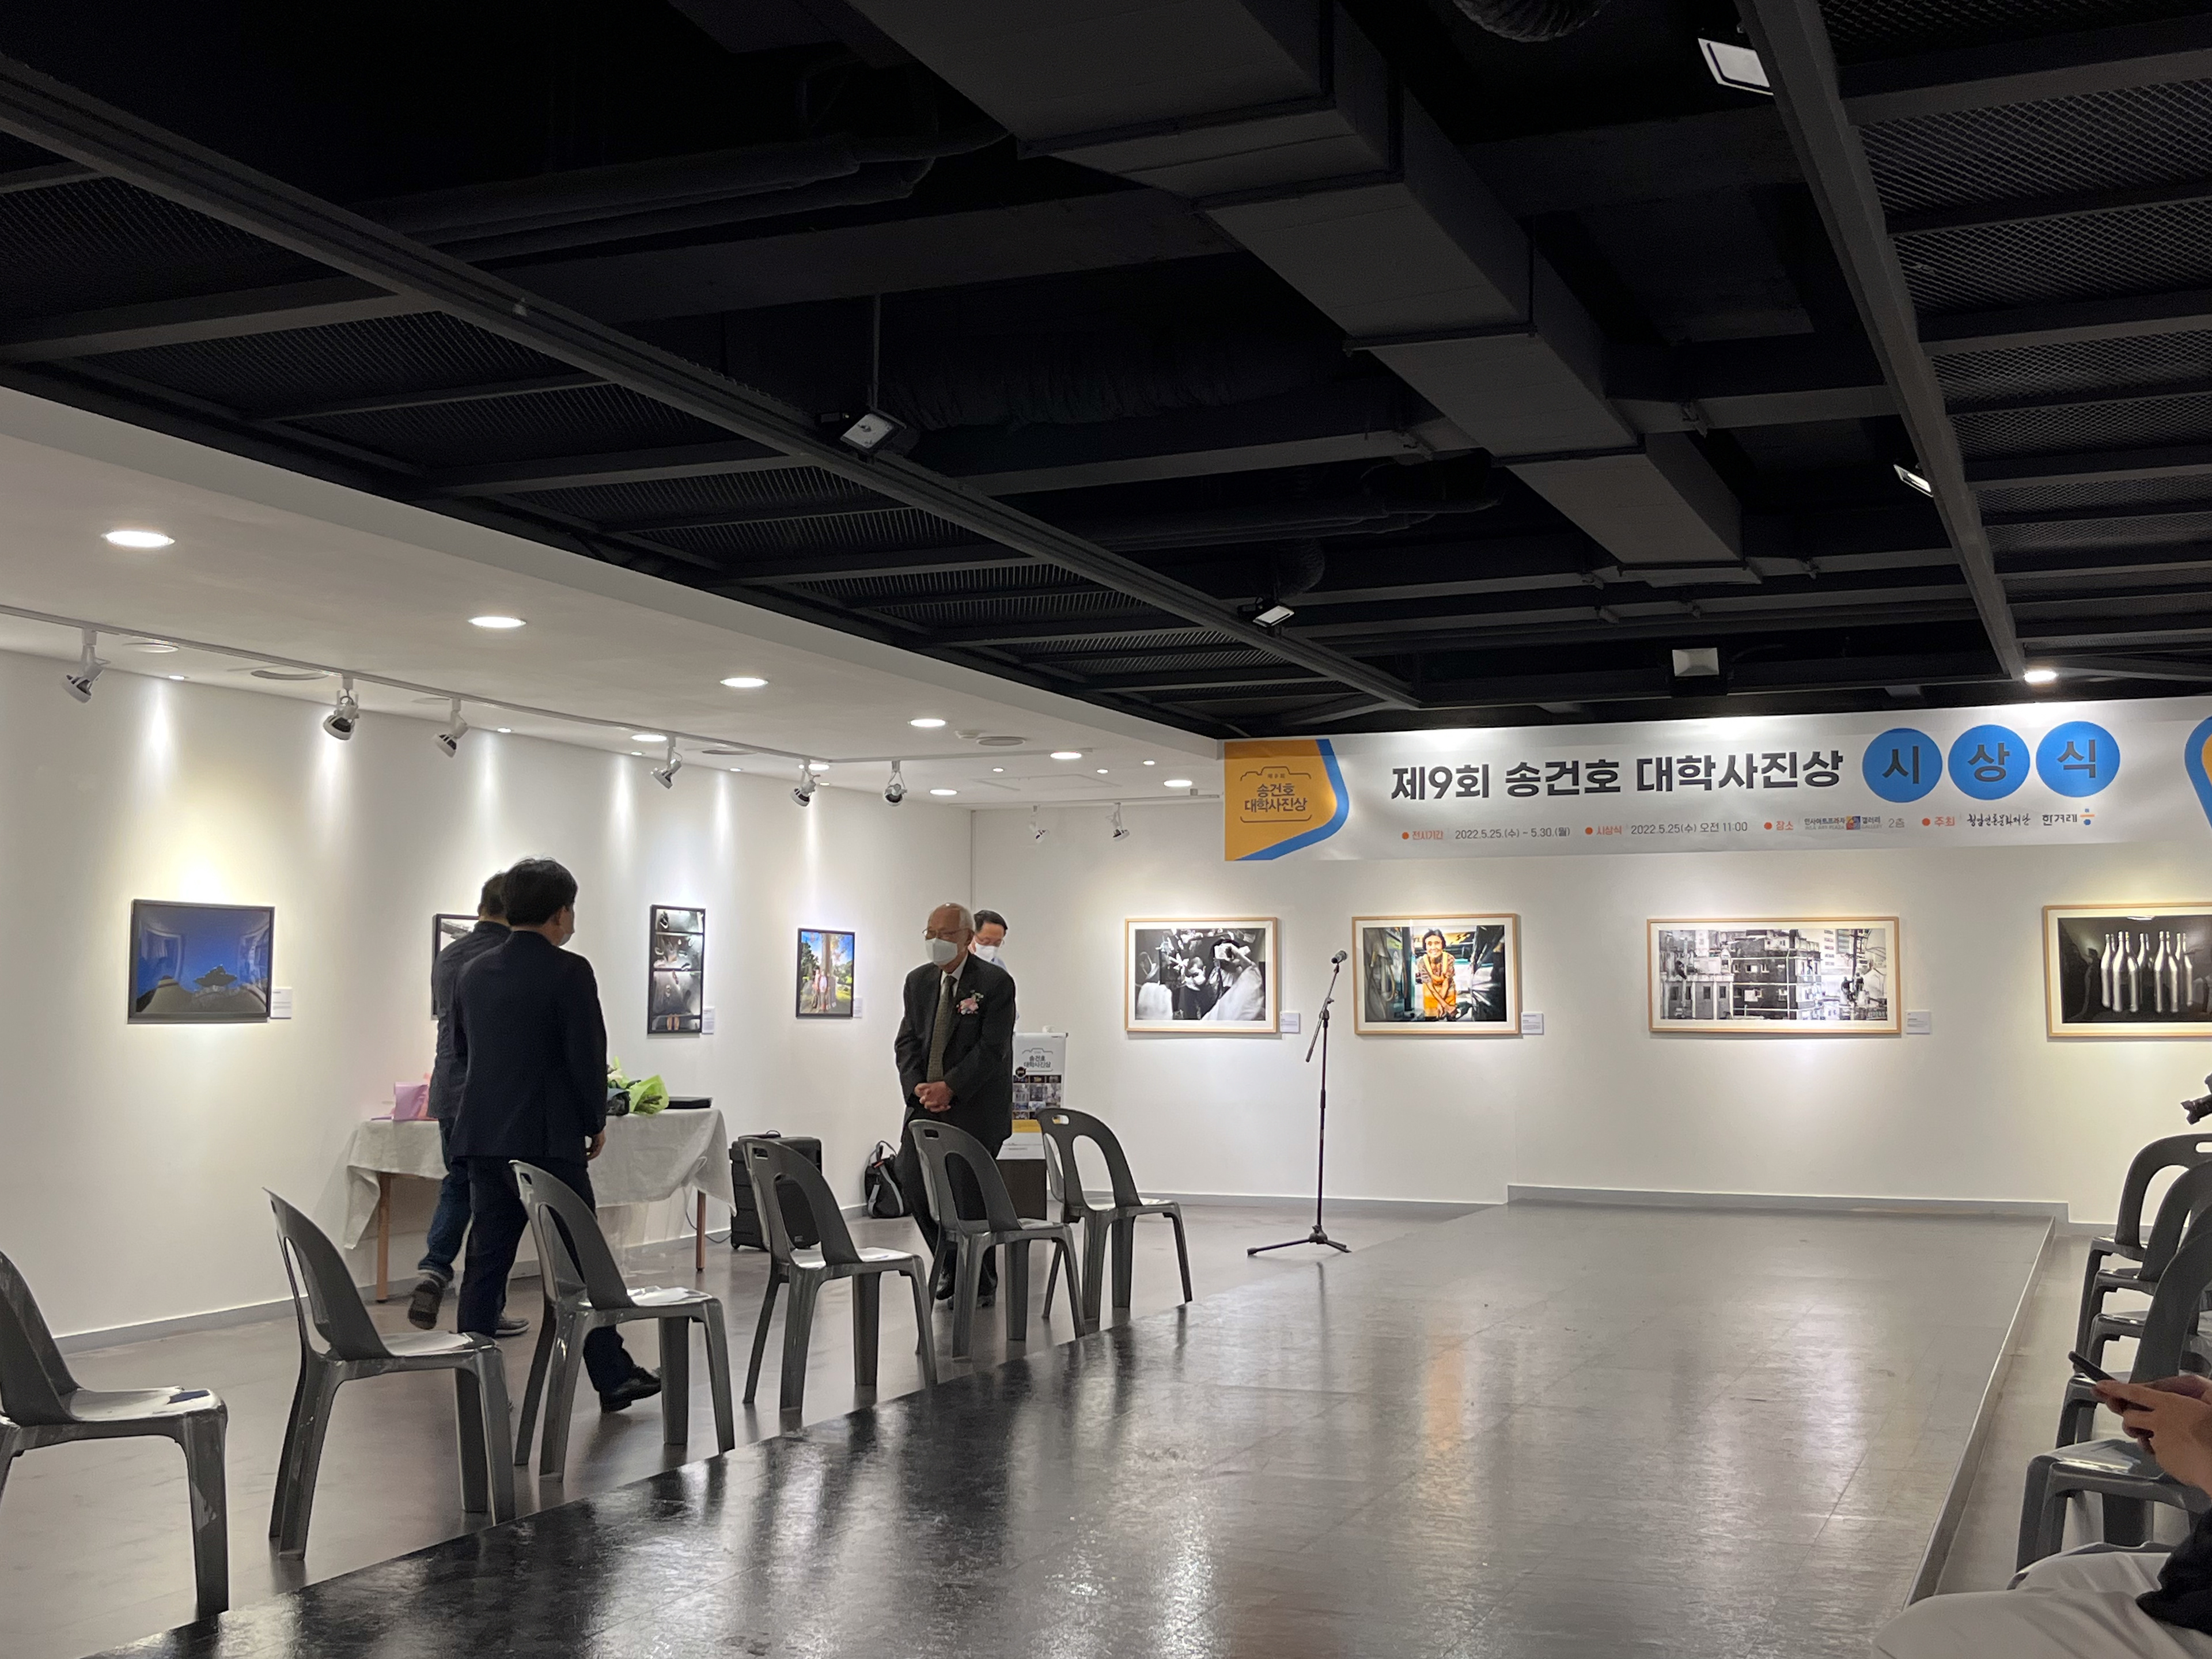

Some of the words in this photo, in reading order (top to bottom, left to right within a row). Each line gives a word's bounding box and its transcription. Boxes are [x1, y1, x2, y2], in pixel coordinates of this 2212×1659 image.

[1391, 763, 1490, 800] 제9회
[1505, 759, 1621, 797] 송건호
[1636, 750, 1843, 792] 대학사진상
[1256, 783, 1296, 798] 송건호
[1244, 797, 1308, 813] 대학사진상
[1596, 825, 1623, 835] 시상식
[1700, 822, 1719, 833] 오전
[1723, 821, 1748, 832] 11:00
[1775, 820, 1794, 831] 장소
[1861, 816, 1881, 824] 갤러리
[1888, 817, 1905, 828] 2층
[1934, 816, 1955, 827] 주최
[2041, 814, 2078, 826] 한겨레
[1412, 830, 1444, 840] 전시기간
